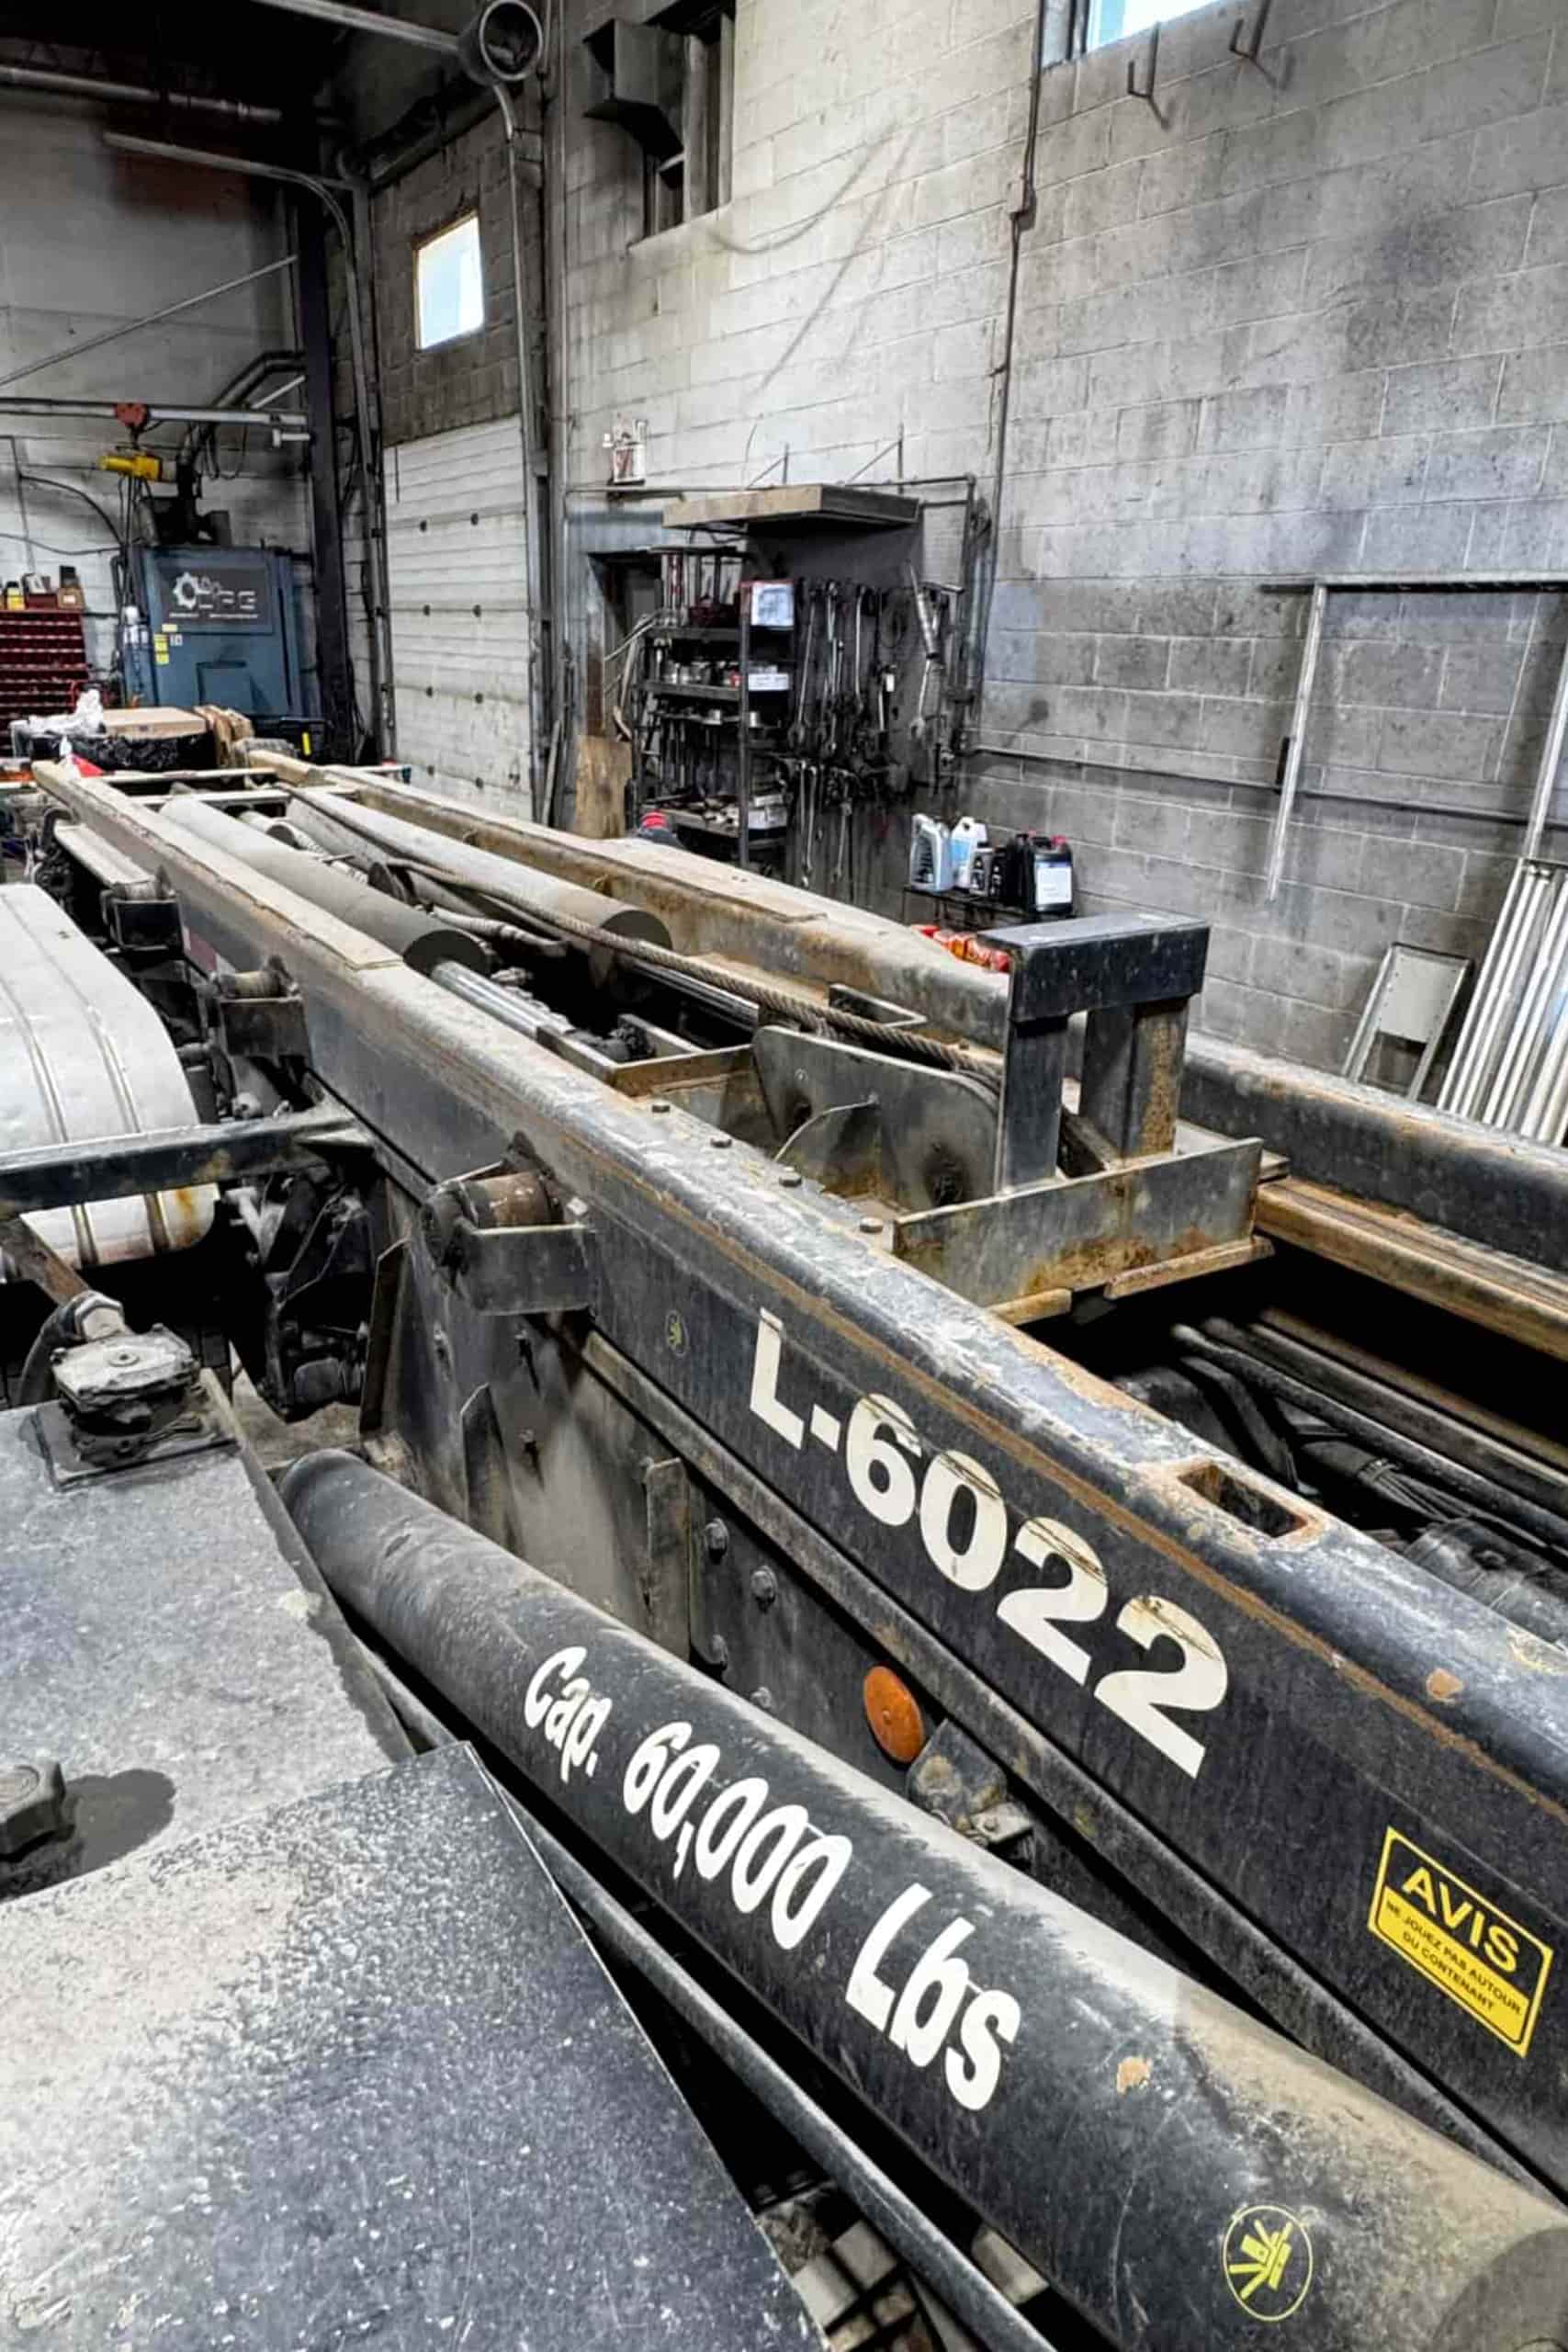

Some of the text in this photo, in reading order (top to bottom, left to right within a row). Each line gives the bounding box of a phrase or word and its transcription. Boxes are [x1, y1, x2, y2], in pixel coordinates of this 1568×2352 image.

[750, 1306, 1229, 1779] L-6022
[525, 1646, 1021, 2110] Cap. 60,000 Lbs
[1401, 1866, 1520, 1973] AVIS
[1386, 1900, 1522, 2015] NE JOUEZ PAS AUTOUR
[1403, 1930, 1495, 2011] DU CONTENANT
